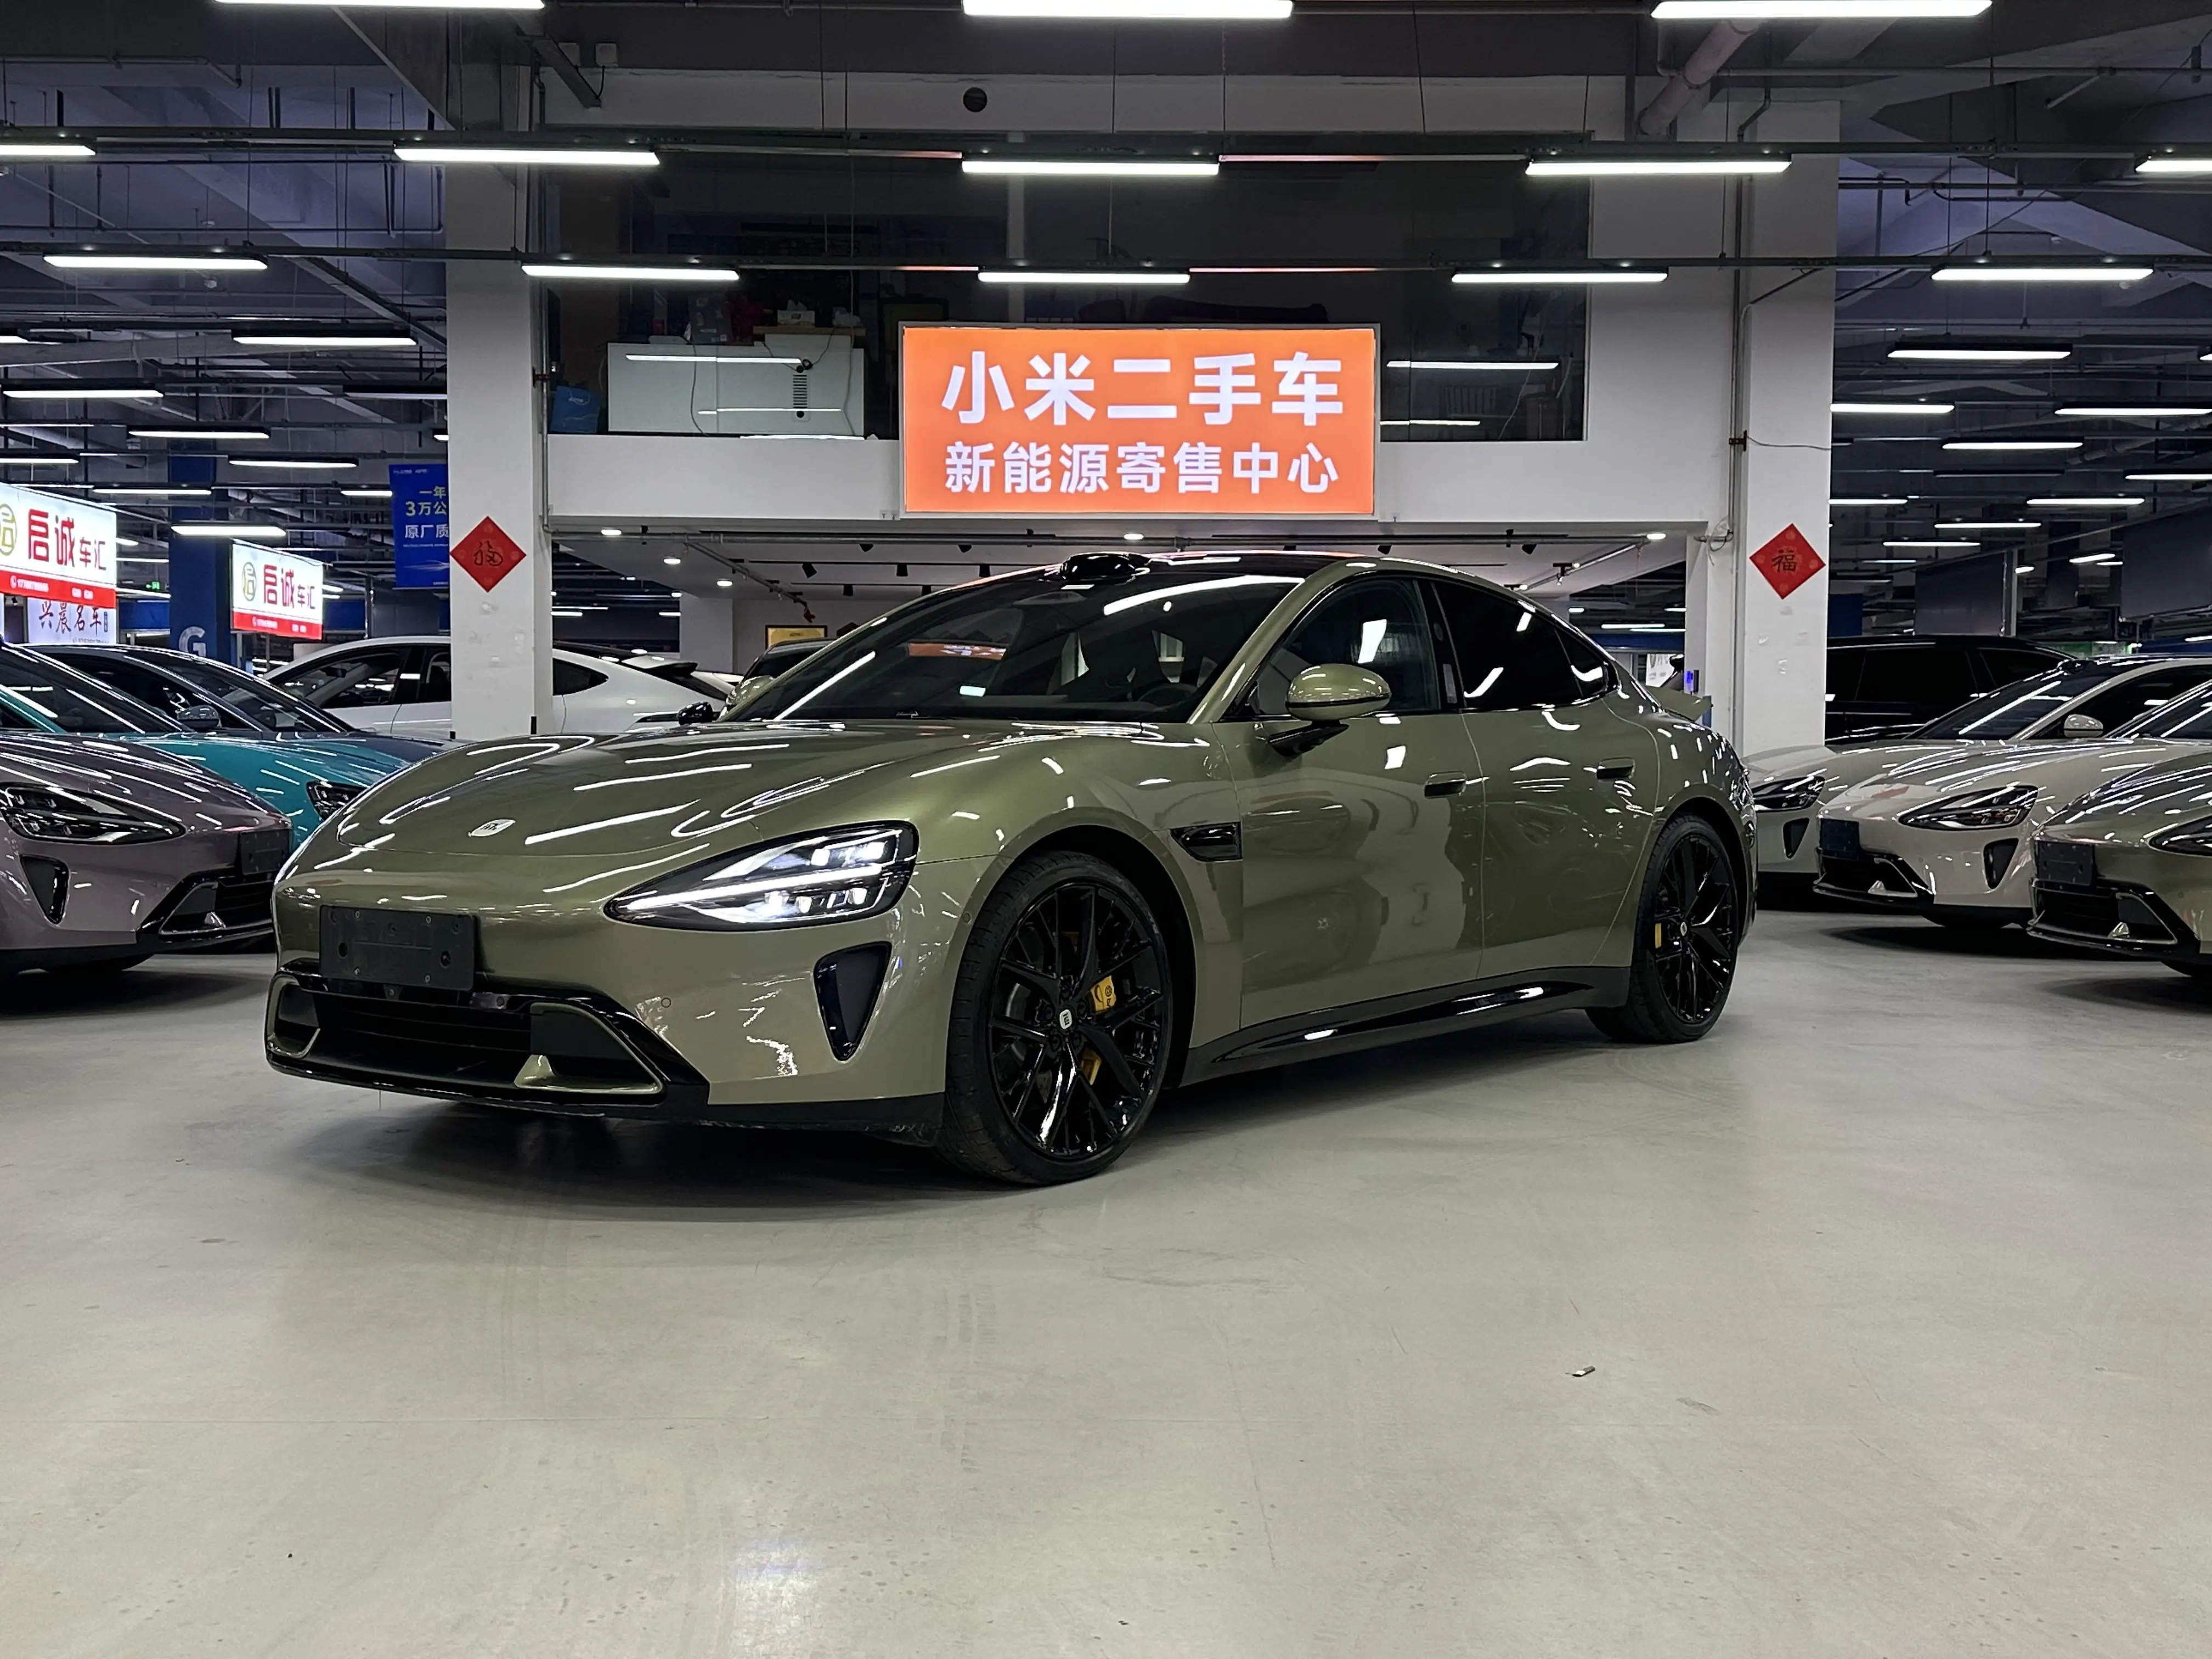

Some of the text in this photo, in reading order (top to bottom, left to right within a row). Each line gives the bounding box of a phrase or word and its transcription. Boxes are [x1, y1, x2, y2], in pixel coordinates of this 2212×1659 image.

[941, 351, 1343, 426] 小米二手车
[945, 441, 1339, 494] 新能源寄售中心
[29, 508, 106, 571] 启诚车汇
[1771, 549, 1798, 573] 福
[263, 563, 316, 610] 启诚车汇
